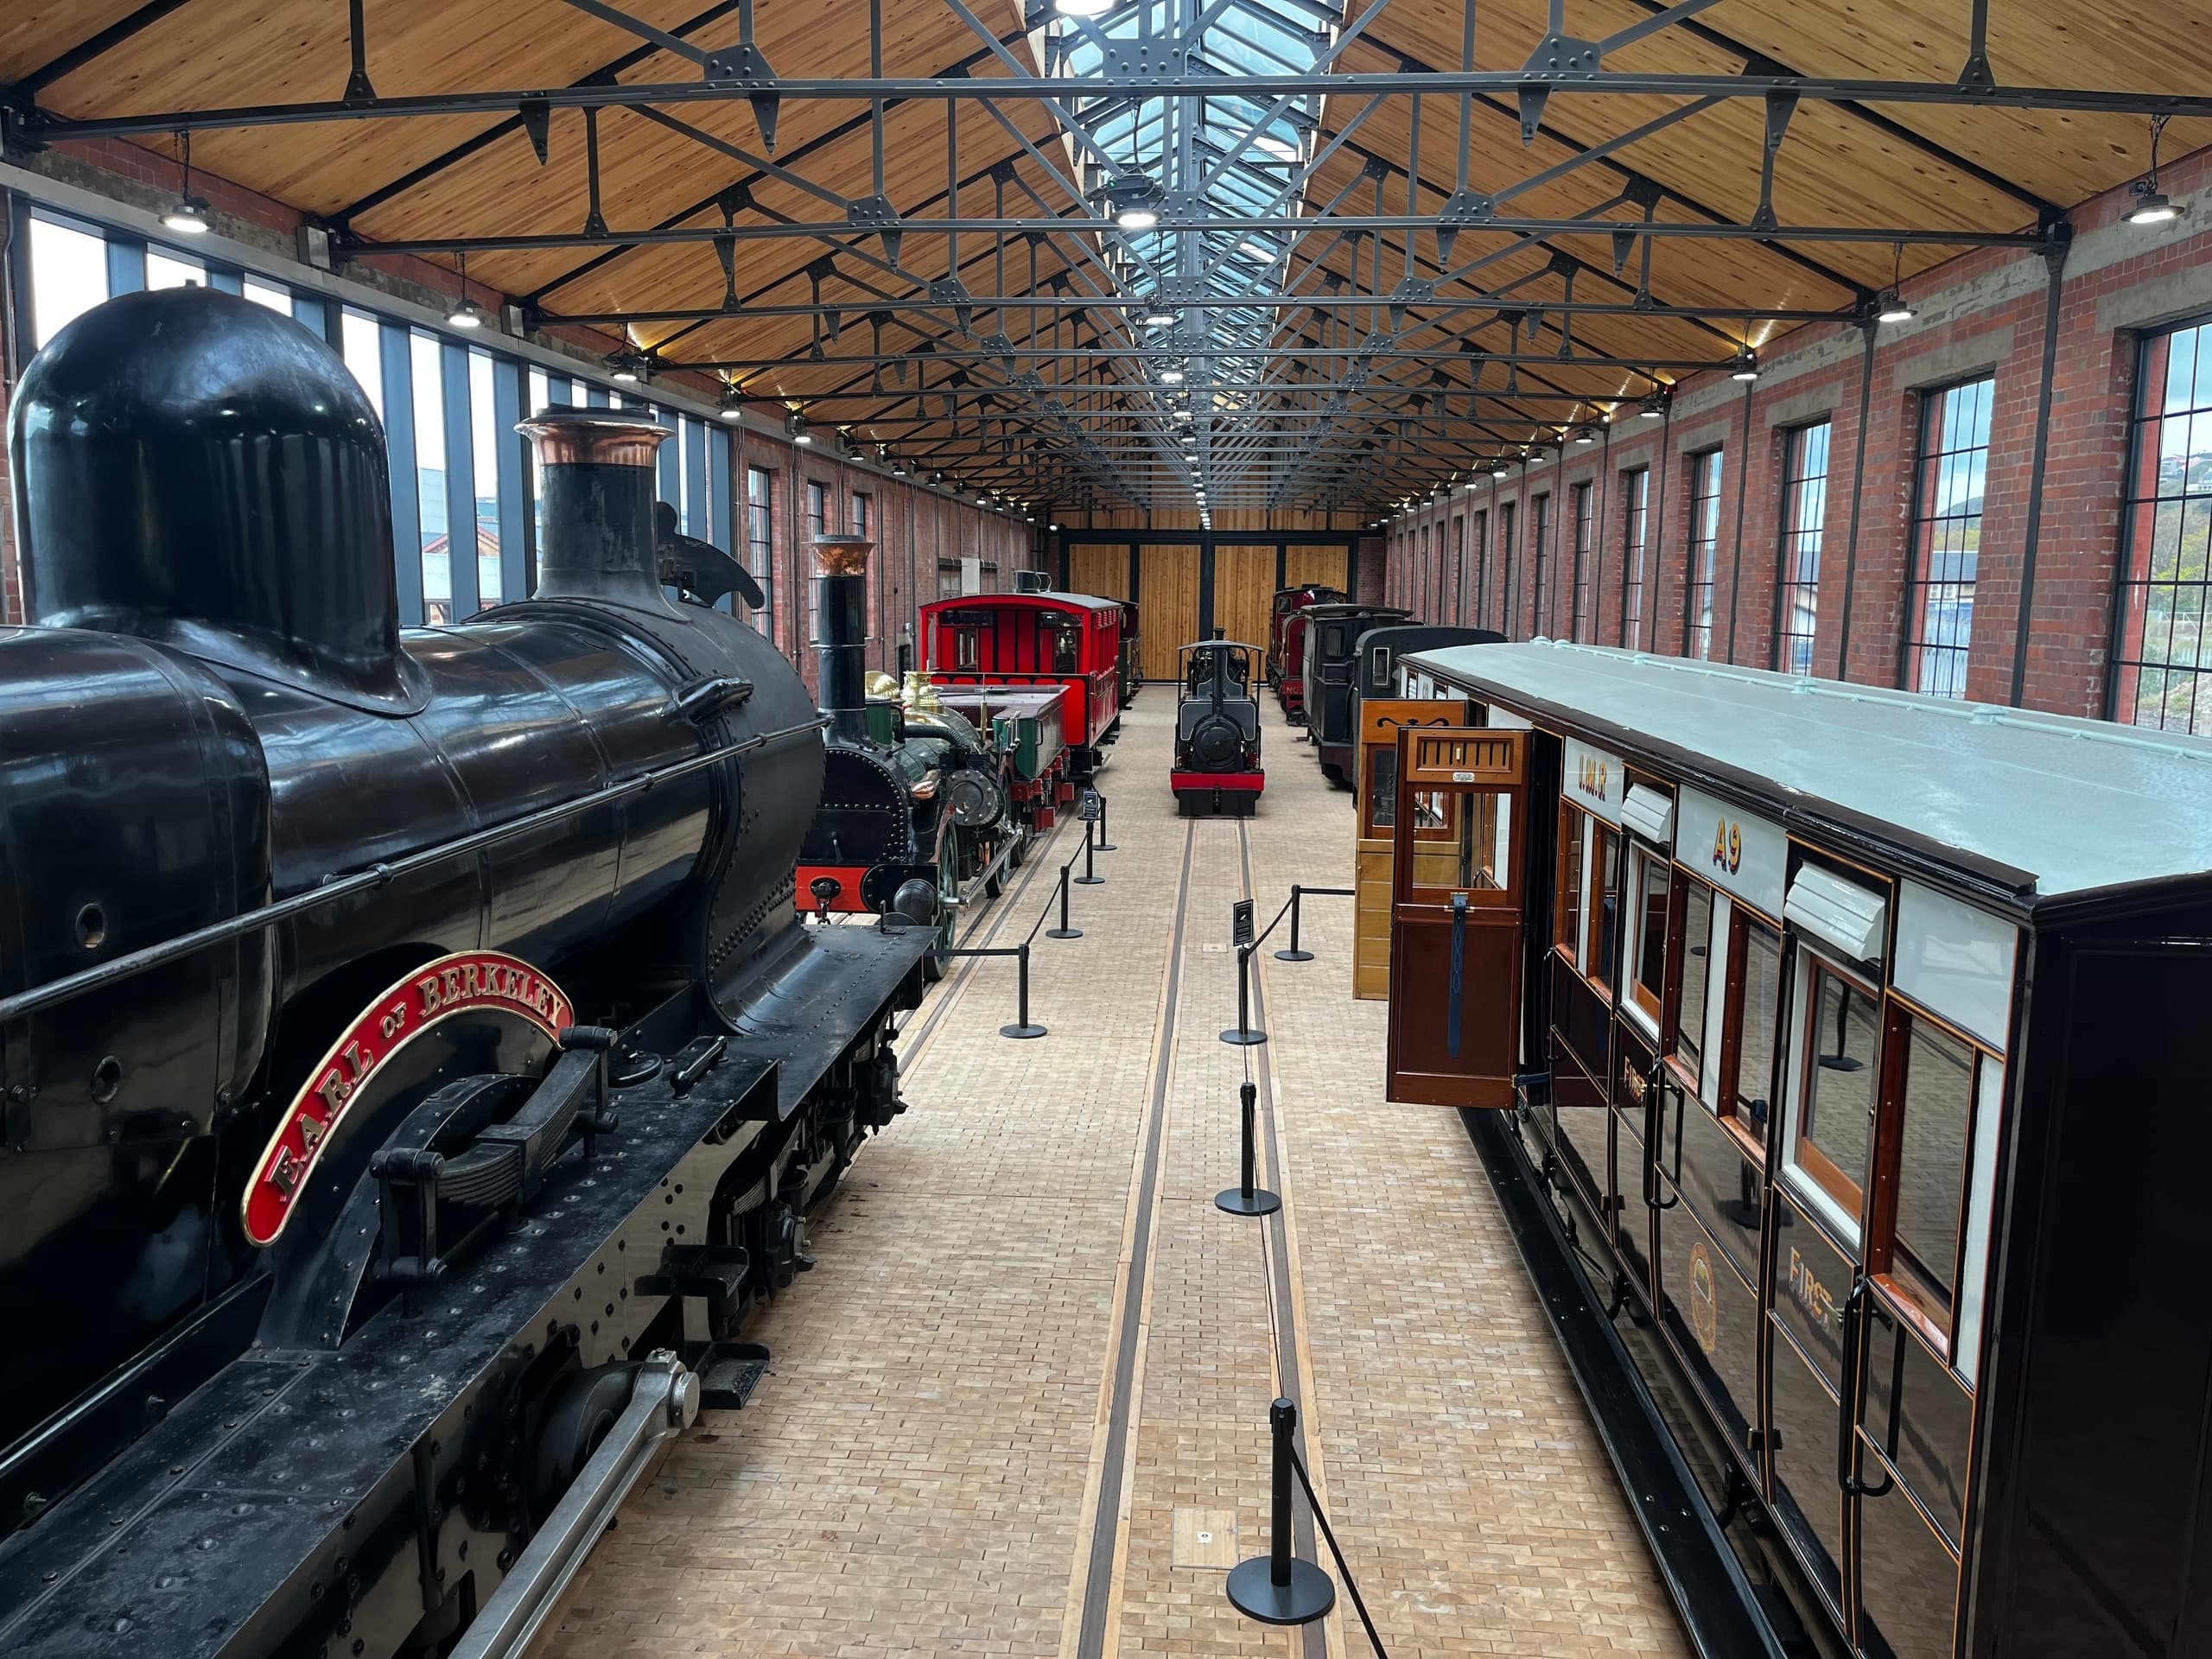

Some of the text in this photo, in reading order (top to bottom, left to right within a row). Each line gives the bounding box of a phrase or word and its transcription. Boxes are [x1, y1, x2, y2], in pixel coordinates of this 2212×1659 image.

[1713, 815, 1742, 876] A9
[264, 963, 564, 1203] EARL OF BERKELEY
